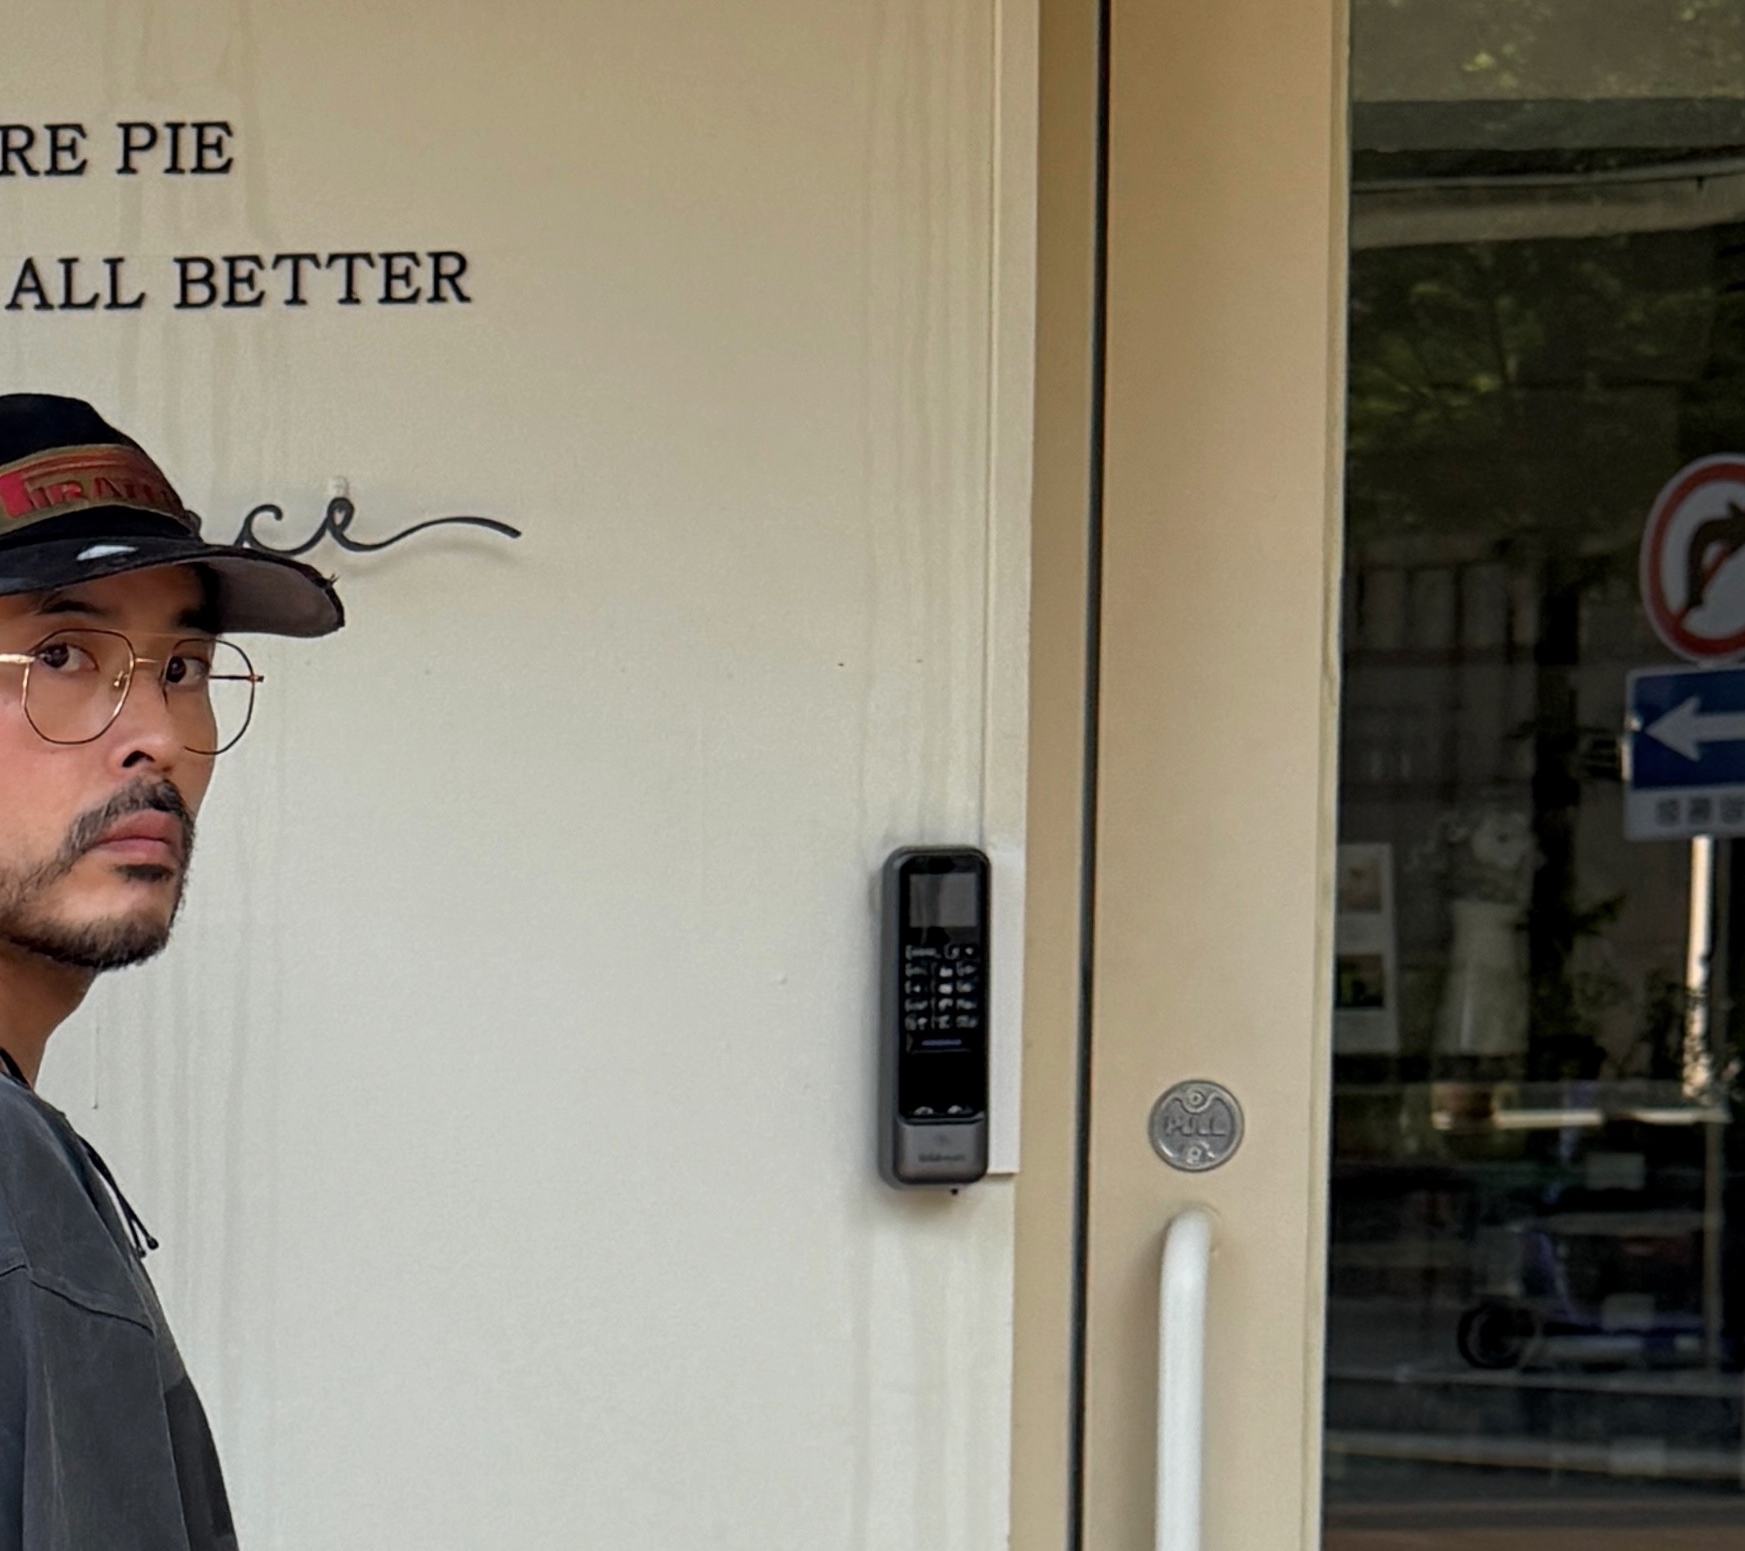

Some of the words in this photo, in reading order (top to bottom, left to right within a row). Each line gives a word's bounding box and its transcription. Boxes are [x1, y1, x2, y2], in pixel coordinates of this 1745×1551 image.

[115, 120, 235, 175] PIE
[4, 256, 146, 311] ALL
[172, 250, 472, 309] BETTER
